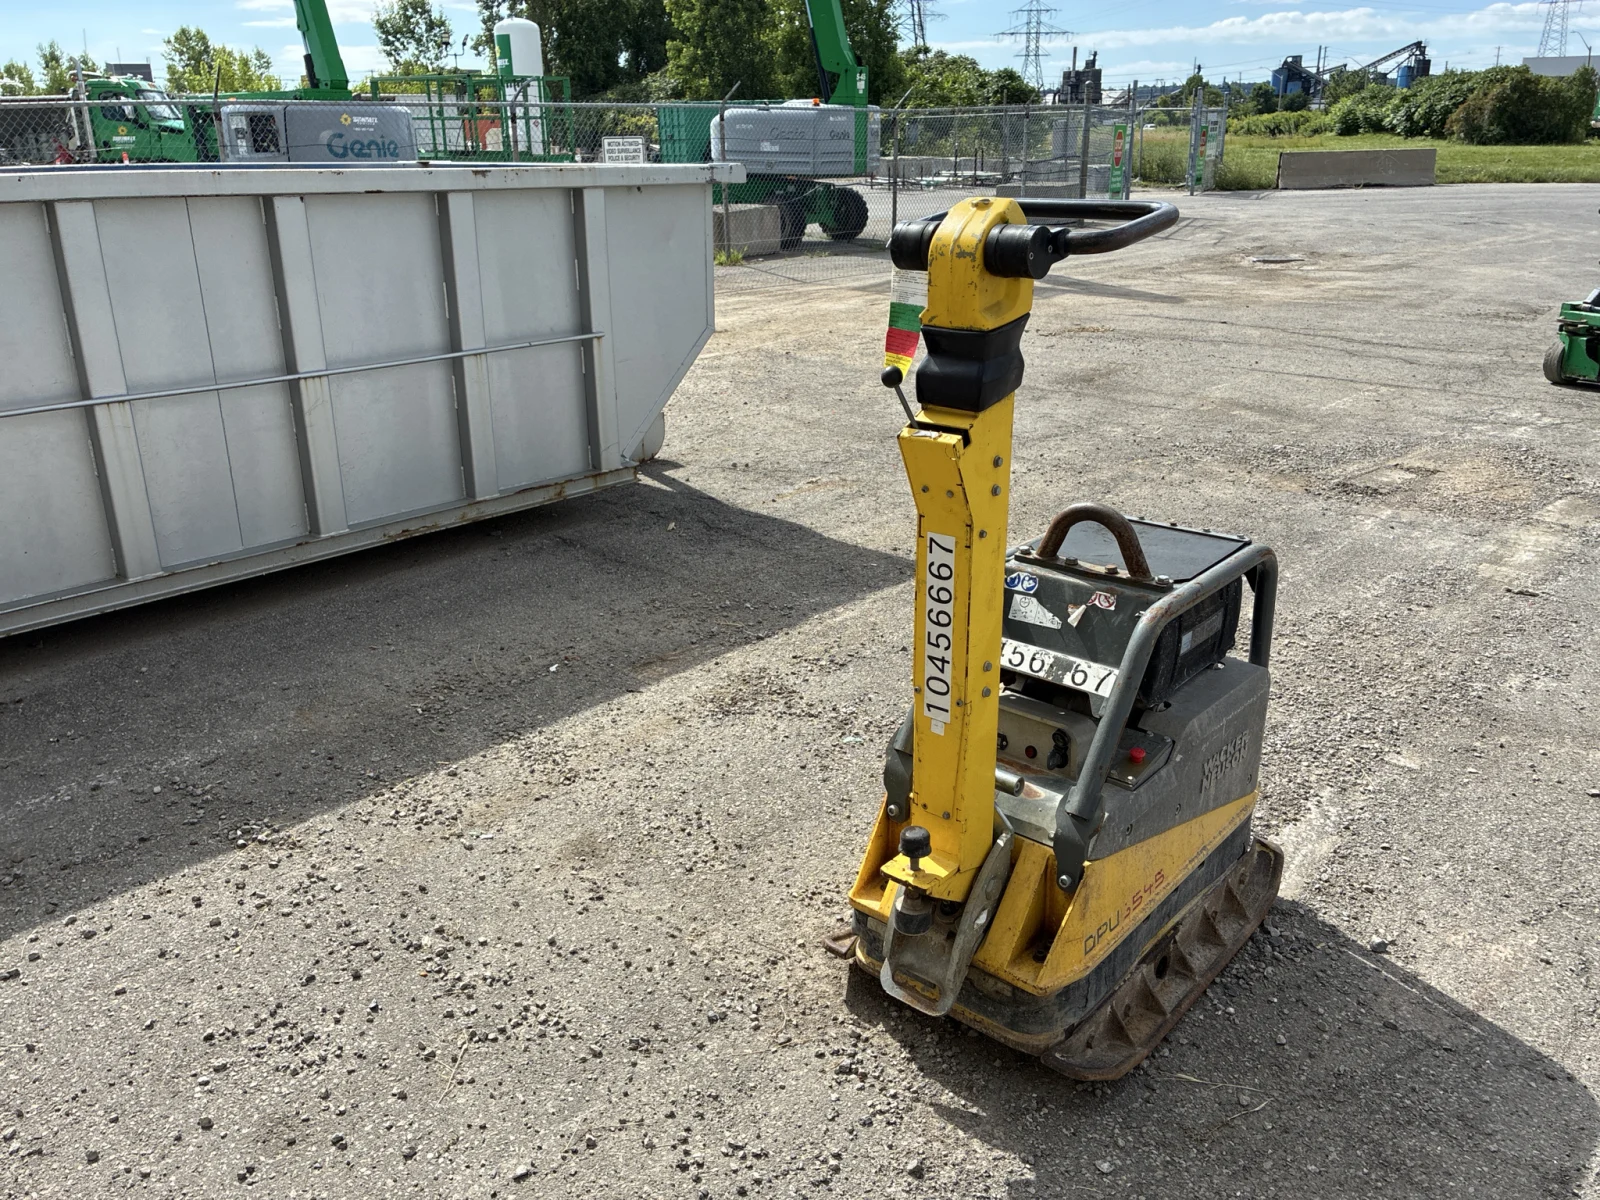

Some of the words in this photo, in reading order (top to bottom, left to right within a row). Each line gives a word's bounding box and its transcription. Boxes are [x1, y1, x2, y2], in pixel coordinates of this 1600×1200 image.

[326, 132, 399, 158] Genie
[926, 537, 953, 713] 10456667
[1200, 747, 1249, 795] NEUSON
[1202, 730, 1250, 777] WACKER
[1084, 910, 1120, 956] DPU
